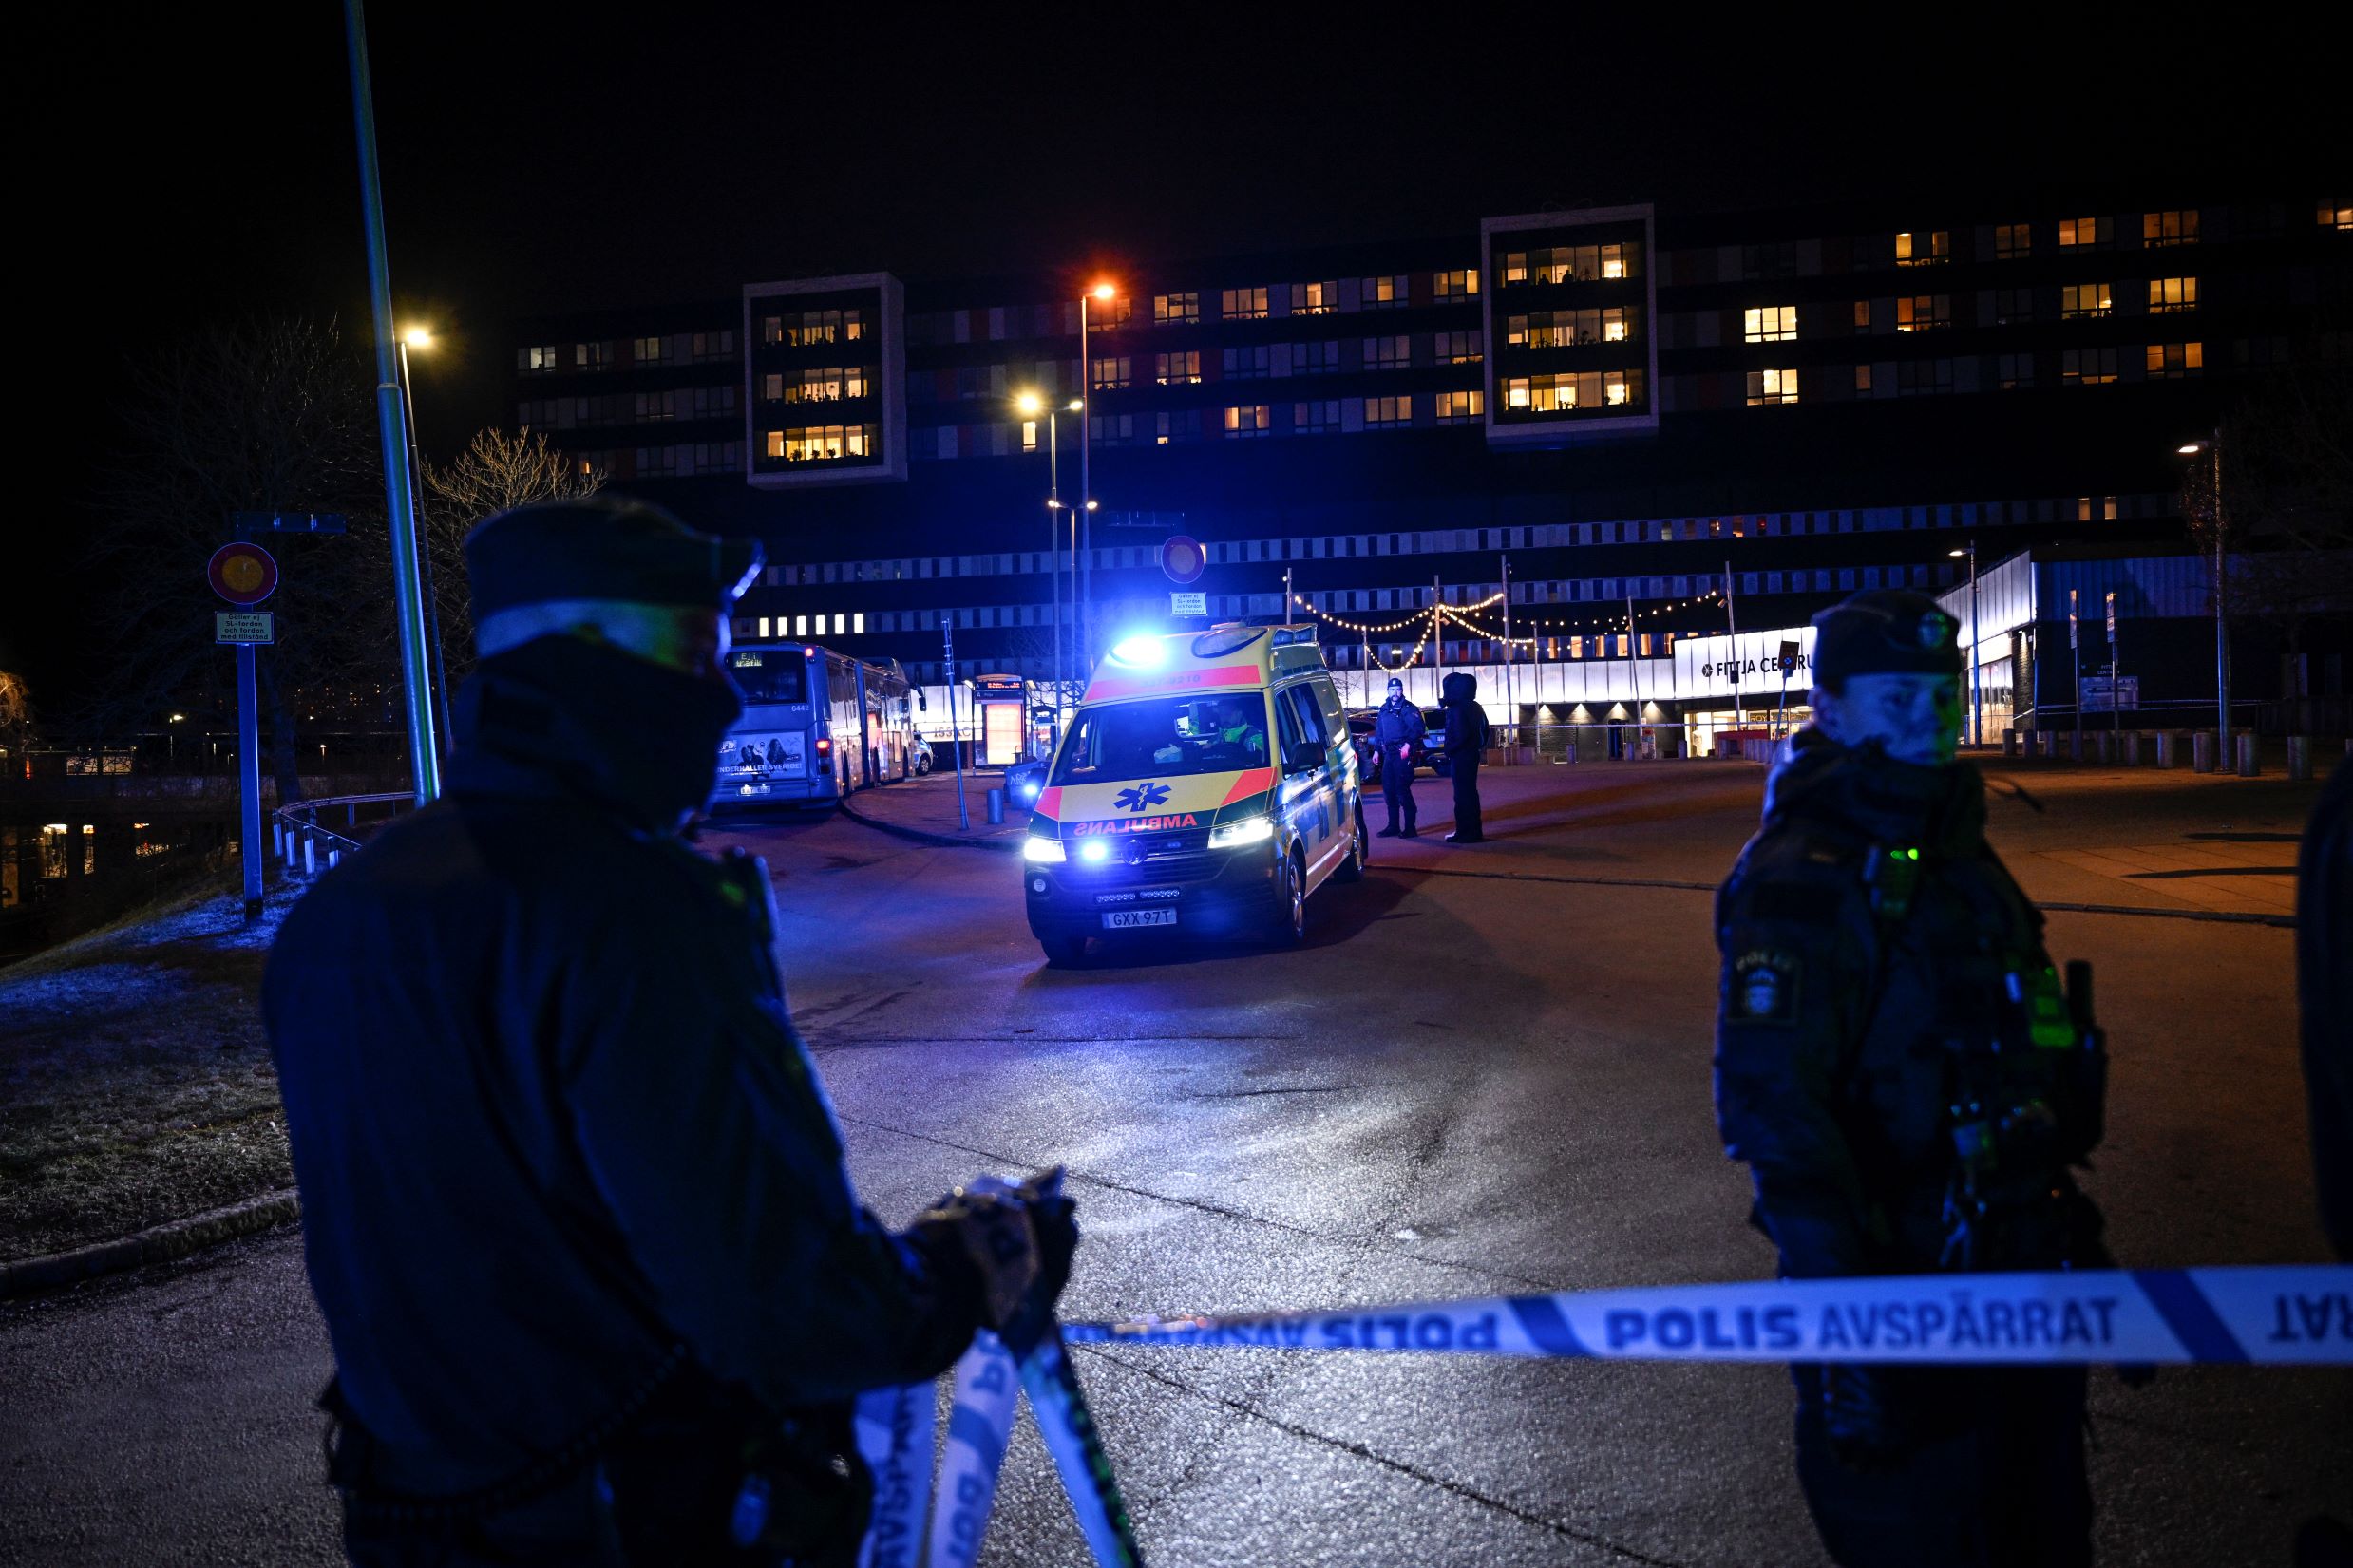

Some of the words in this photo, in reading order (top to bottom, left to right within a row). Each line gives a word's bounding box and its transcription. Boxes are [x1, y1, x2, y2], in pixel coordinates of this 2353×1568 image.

[735, 659, 762, 668] trafik
[1113, 913, 1140, 926] GXX
[1143, 910, 1170, 925] 97T
[1319, 1313, 1498, 1350] POLIS
[1605, 1305, 1800, 1349] POLIS
[1817, 1290, 2118, 1349] AVSPÄRRAT
